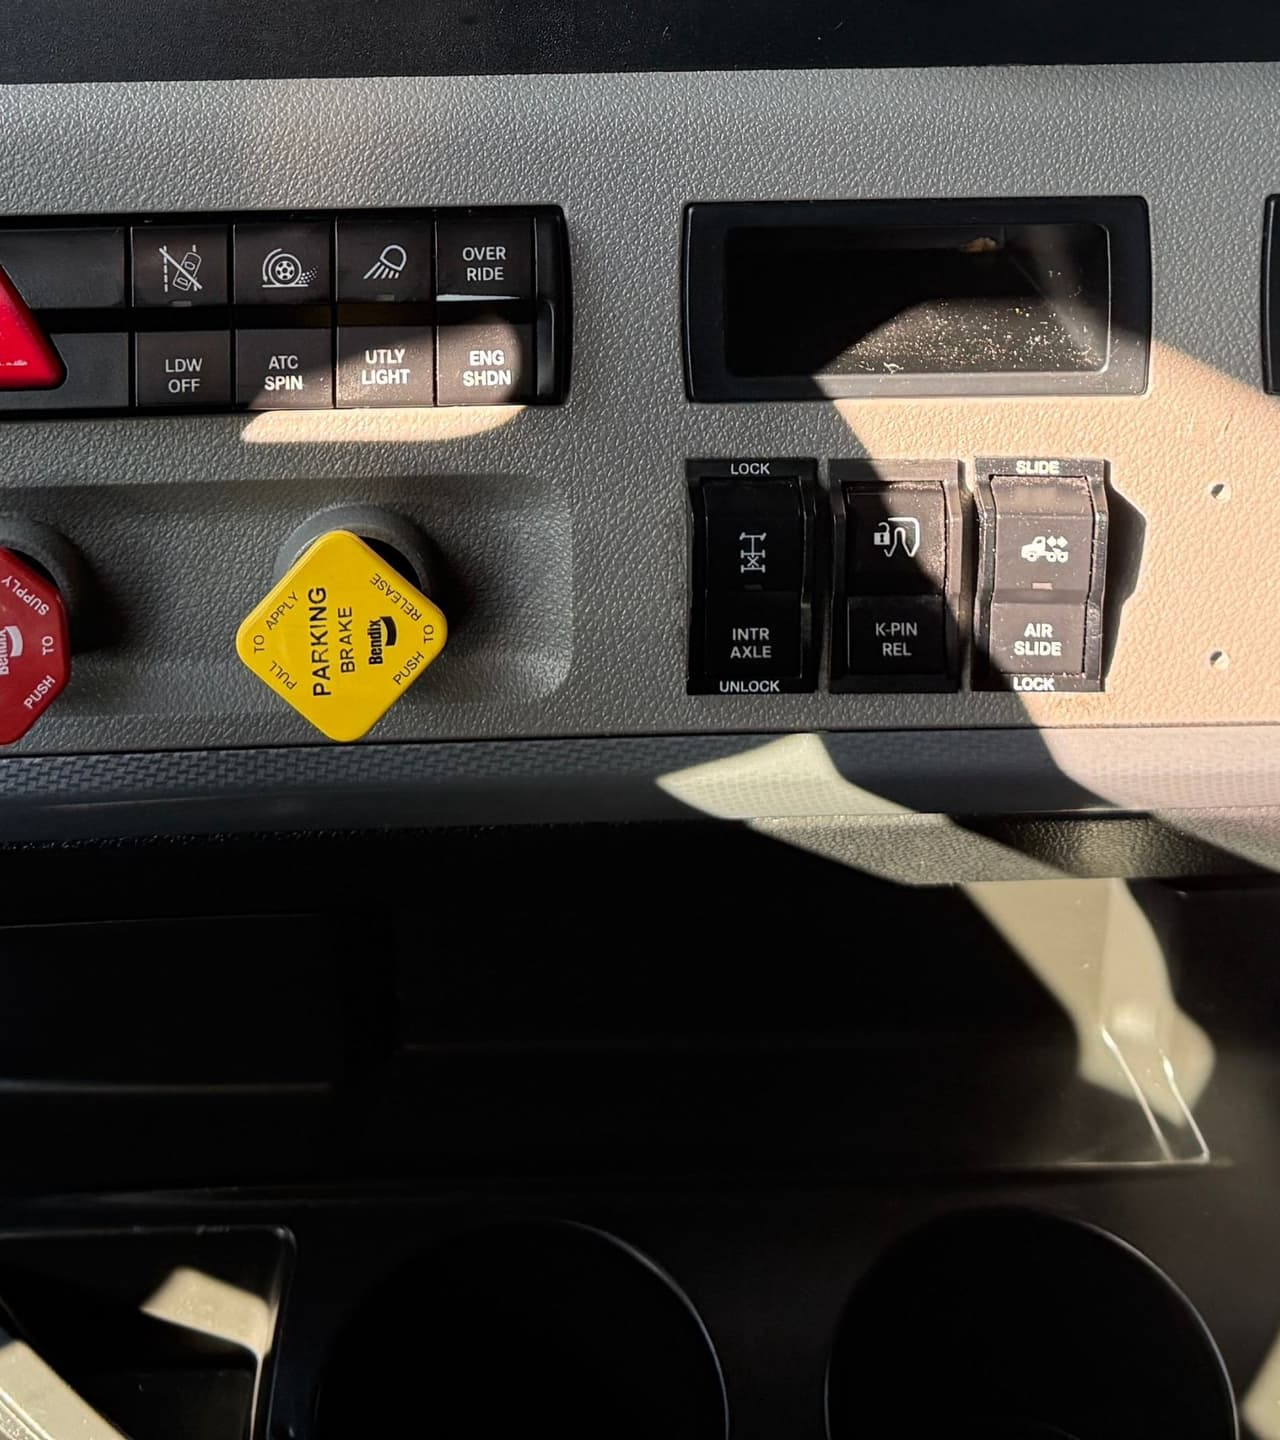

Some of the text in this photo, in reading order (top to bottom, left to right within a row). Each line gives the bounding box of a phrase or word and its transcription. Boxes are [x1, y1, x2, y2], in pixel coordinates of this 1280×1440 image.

[462, 245, 506, 261] OVER
[466, 265, 504, 281] RIDE
[165, 357, 203, 373] LDW
[268, 354, 299, 370] ATC
[364, 349, 406, 366] UTLY
[468, 349, 505, 367] ENG
[167, 377, 201, 393] OFF
[264, 374, 303, 391] SPIN
[361, 368, 410, 387] LIGHT
[463, 368, 512, 387] SHDN
[730, 462, 770, 476] LOCK
[1015, 460, 1060, 475] SLIDE
[369, 572, 435, 686] PUSH TO RELEASE
[732, 627, 770, 641] INTR
[875, 621, 918, 637] K-PIN
[1023, 622, 1053, 639] AIR
[1, 574, 56, 709] PUSH TO SUPPLY
[252, 591, 299, 691] PULL TO APPLY
[308, 586, 332, 697] PARKING
[337, 606, 356, 673] BRAKE
[367, 619, 384, 665] Bendix
[730, 644, 772, 659] AXLE
[882, 642, 912, 657] REL
[1013, 641, 1062, 657] SLIDE
[719, 679, 780, 693] UNLOCK
[1013, 677, 1055, 692] LOCK
